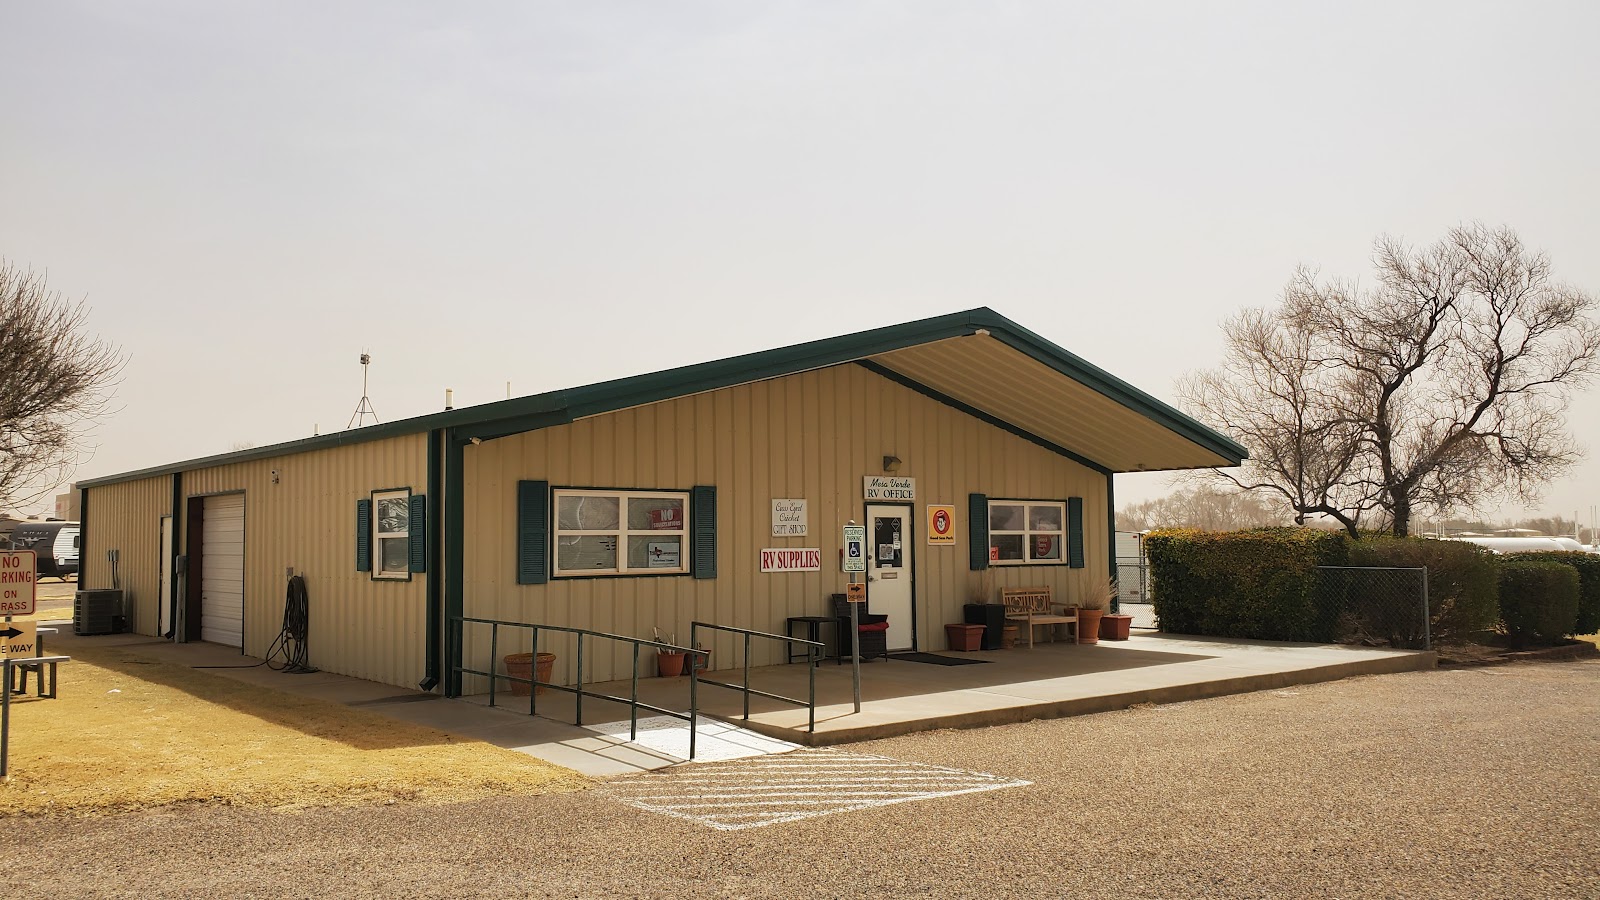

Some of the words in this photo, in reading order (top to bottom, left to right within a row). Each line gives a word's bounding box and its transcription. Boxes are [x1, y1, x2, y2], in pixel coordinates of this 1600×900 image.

[870, 478, 888, 488] Mesa
[889, 478, 911, 489] Verde
[867, 489, 880, 498] RV
[883, 489, 914, 499] OFFICE
[660, 509, 674, 521] NO
[789, 525, 806, 534] SHOP
[2, 556, 20, 569] NO
[762, 551, 776, 570] RV
[777, 550, 820, 569] SUPPLIES
[0, 571, 32, 584] RKING
[3, 590, 18, 599] ON
[0, 601, 28, 611] RASS
[9, 643, 34, 653] WAY
